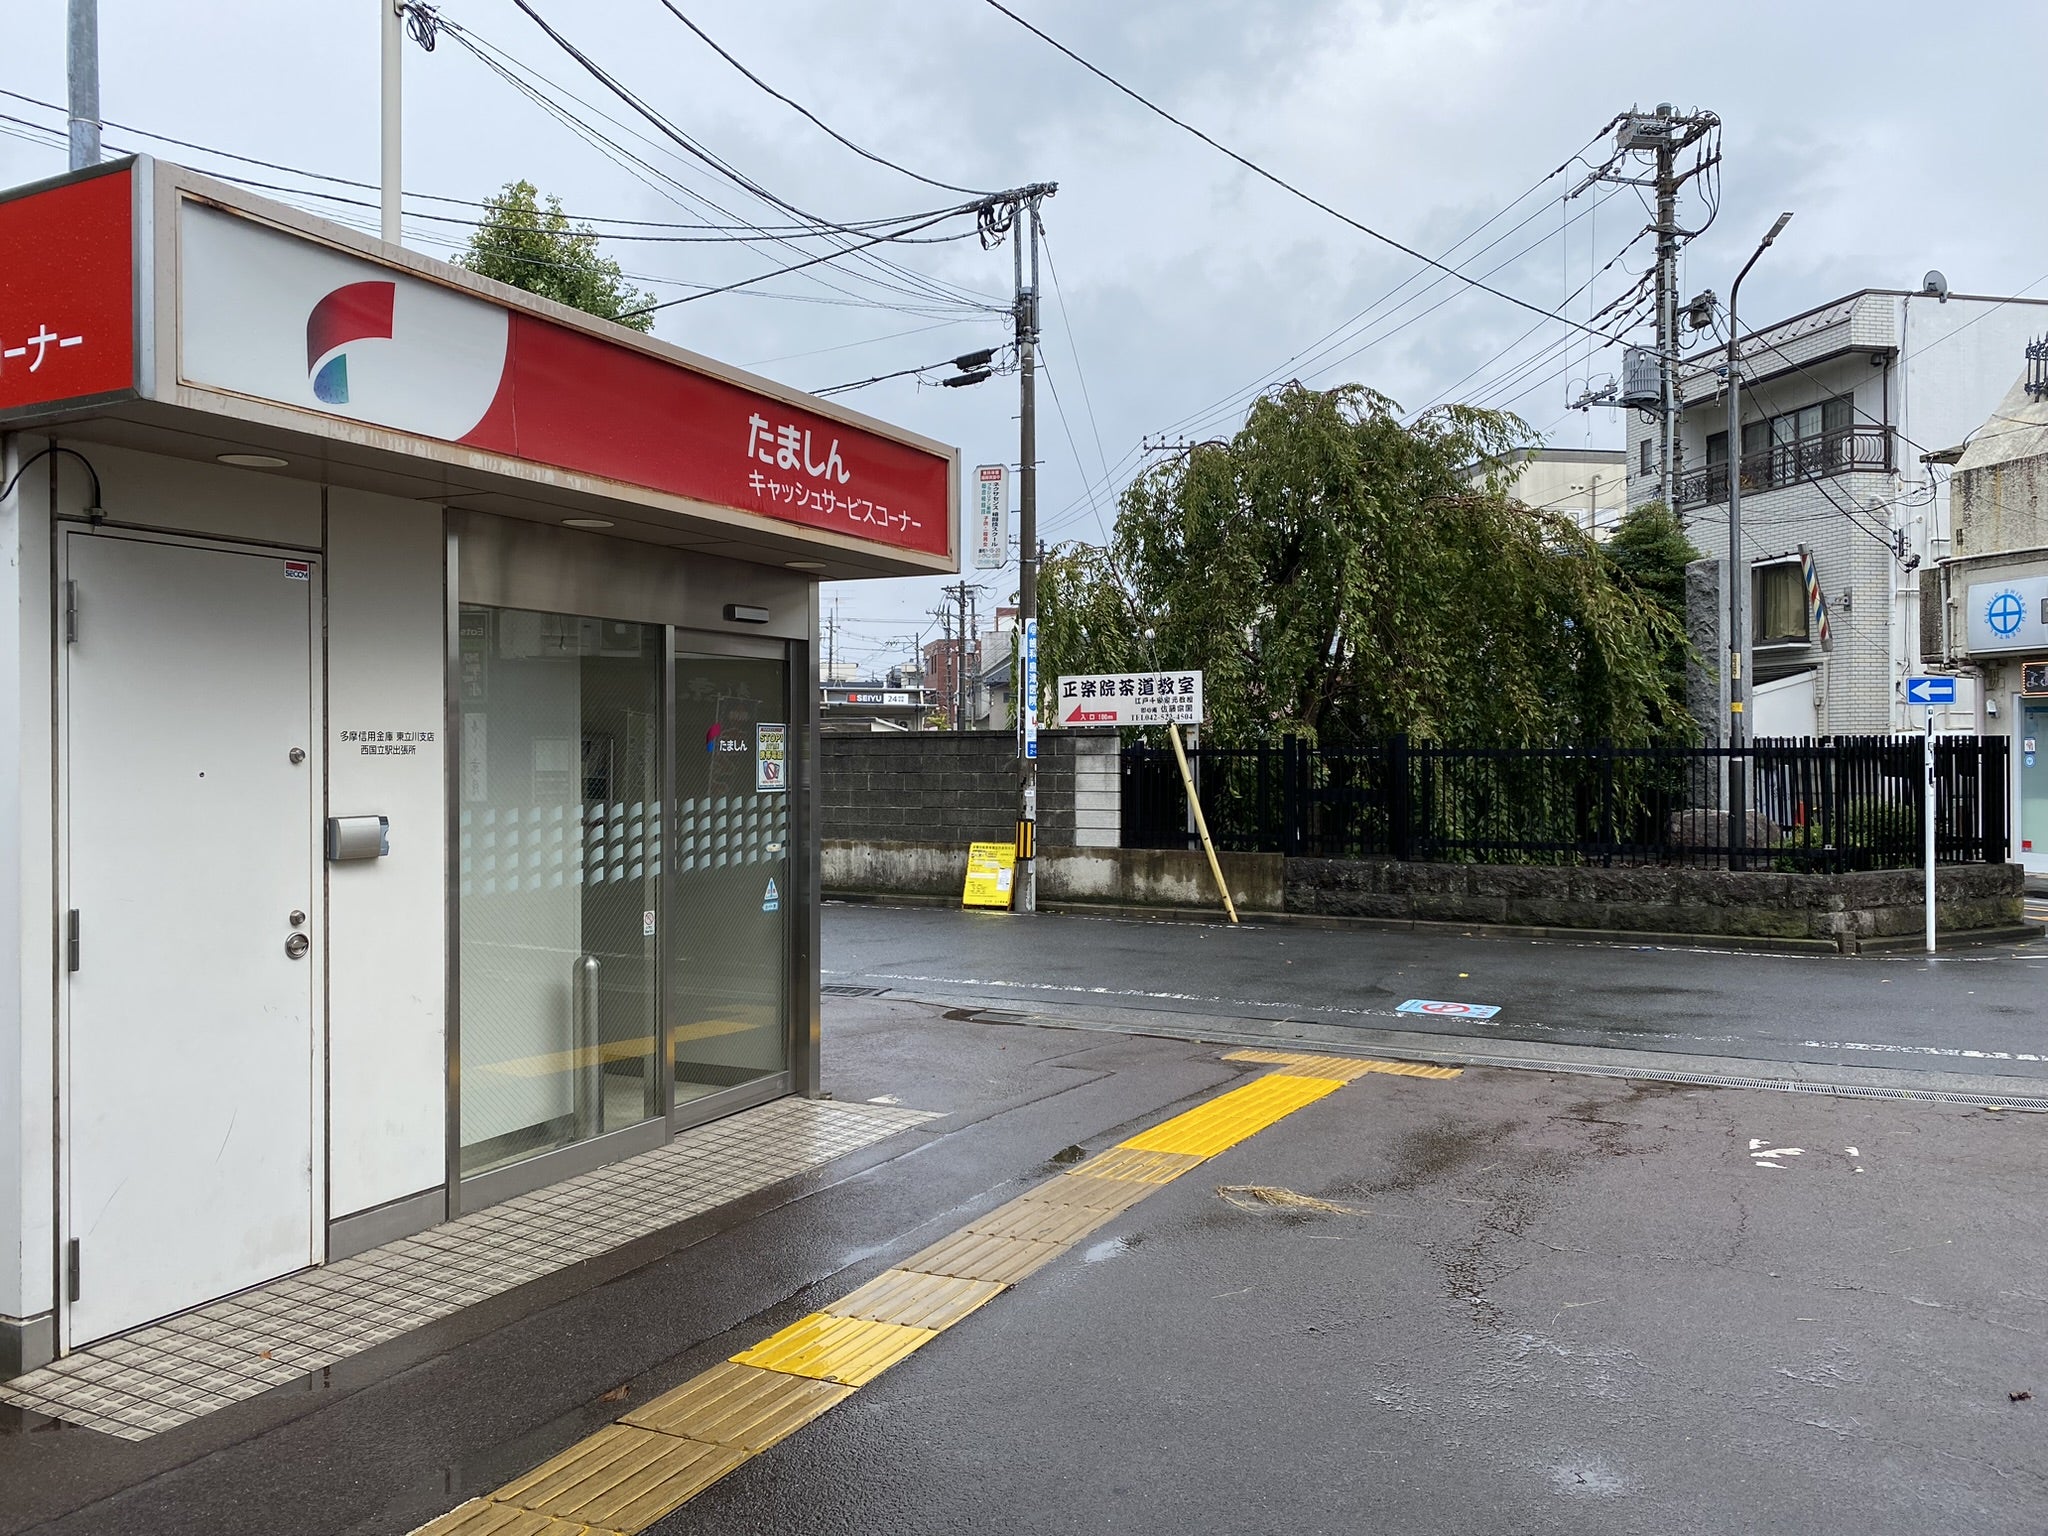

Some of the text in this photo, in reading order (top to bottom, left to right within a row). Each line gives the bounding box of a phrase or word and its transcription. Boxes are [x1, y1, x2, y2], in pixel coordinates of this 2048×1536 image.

[1, 324, 83, 373] ーナー
[748, 412, 850, 485] たましん
[748, 469, 922, 532] キャッシュサービスコーナー
[285, 570, 309, 579] SECOM
[1983, 591, 2001, 624] CLINIC
[2004, 588, 2028, 623] SHIMAZU
[857, 694, 882, 702] SEIYU
[340, 730, 435, 742] 多摩信用金庫 東立川支店
[760, 732, 784, 743] STOP!
[360, 744, 416, 755] 西国立駅出張所
[719, 739, 748, 752] たましん
